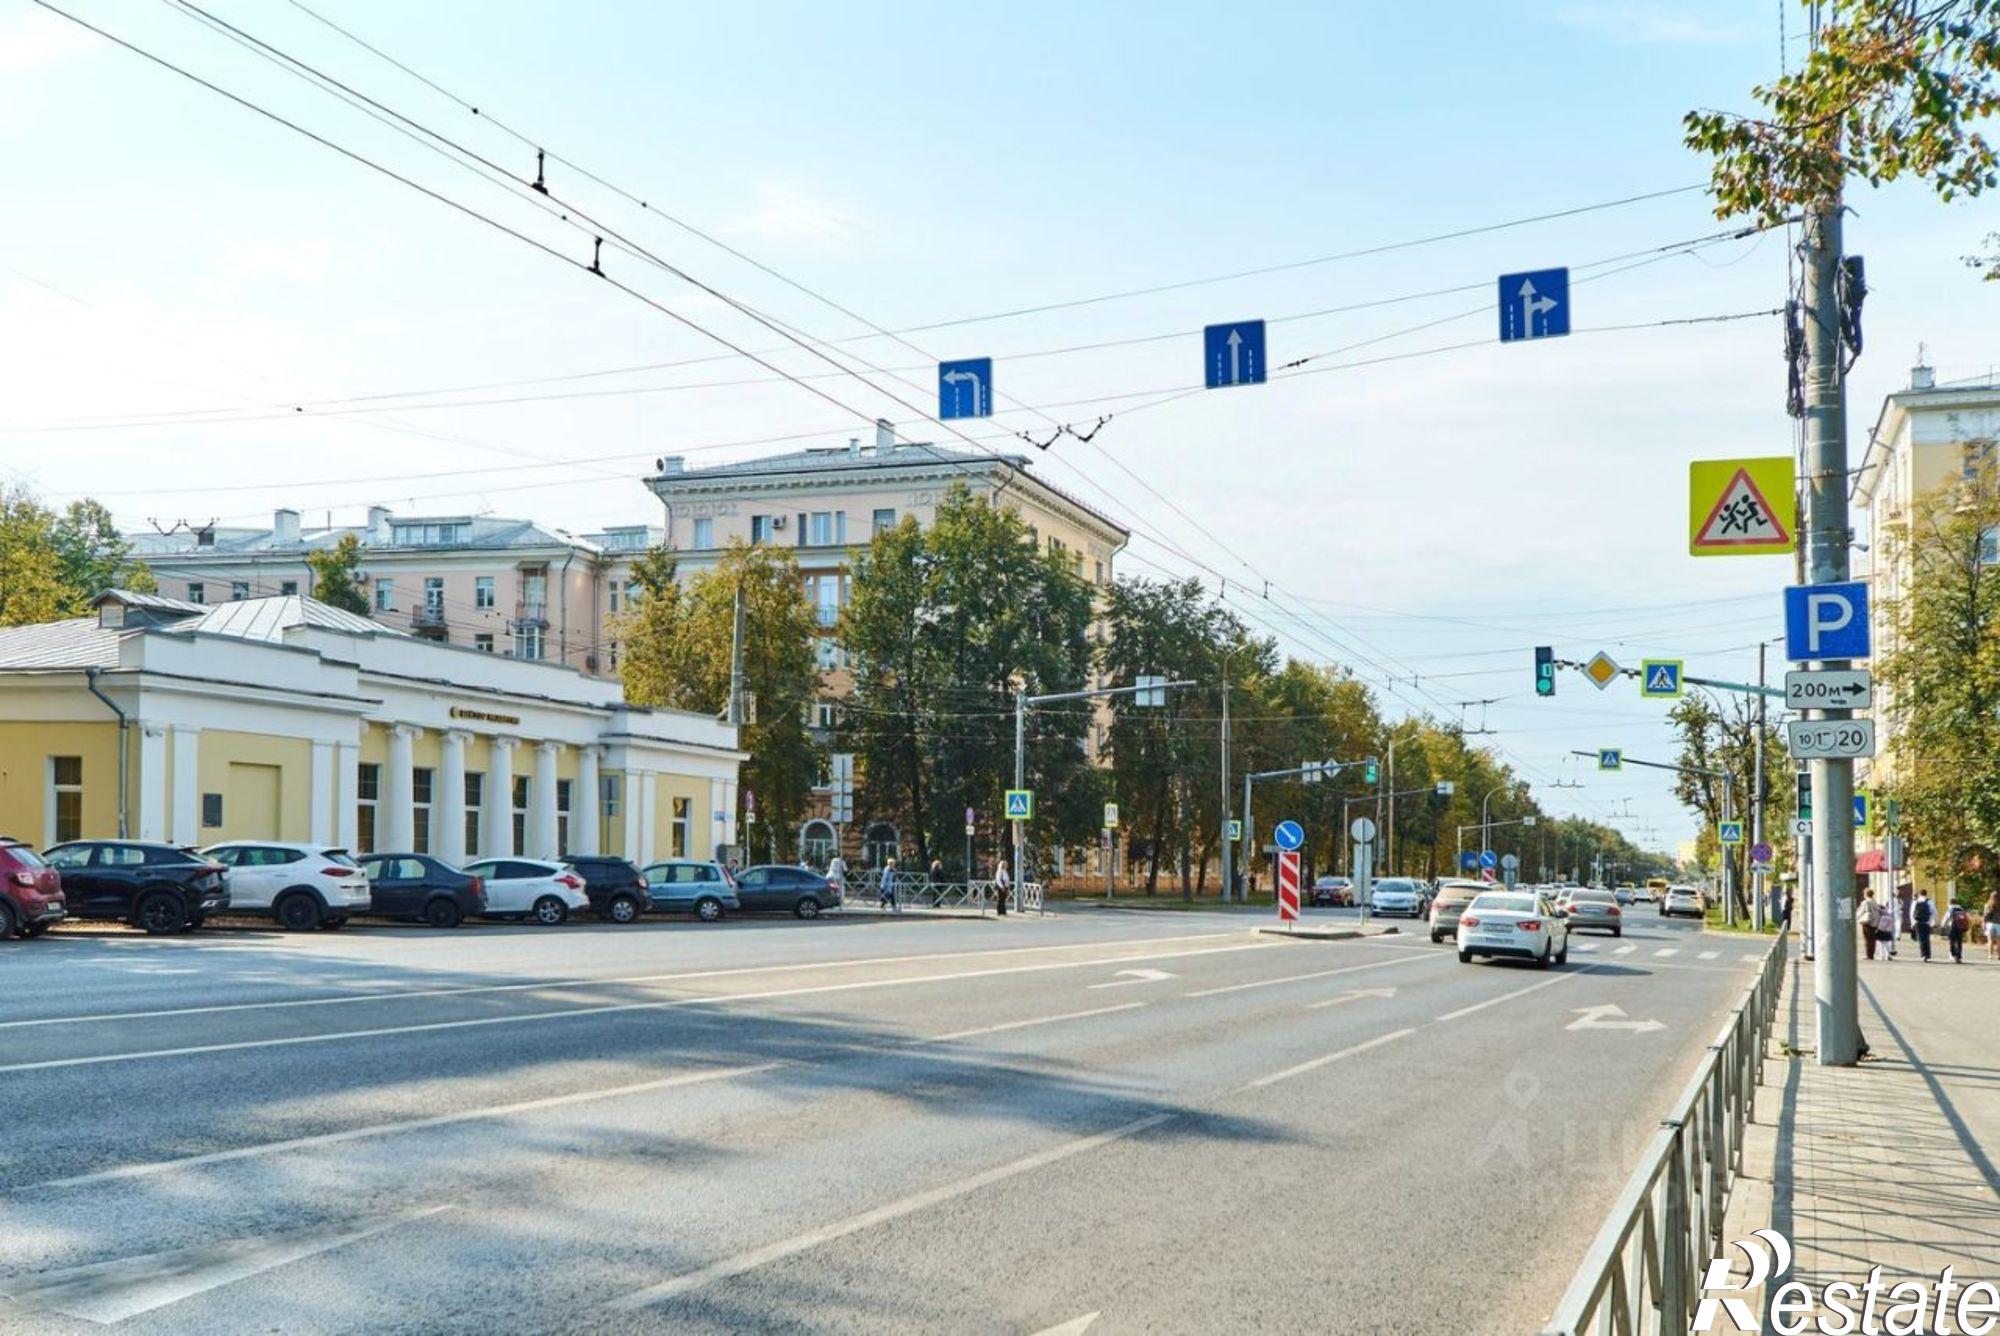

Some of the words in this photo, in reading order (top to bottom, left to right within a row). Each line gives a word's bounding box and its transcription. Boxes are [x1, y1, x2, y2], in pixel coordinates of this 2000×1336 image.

[1808, 594, 1853, 652] P
[1799, 734, 1811, 744] 10
[1839, 730, 1863, 746] 20
